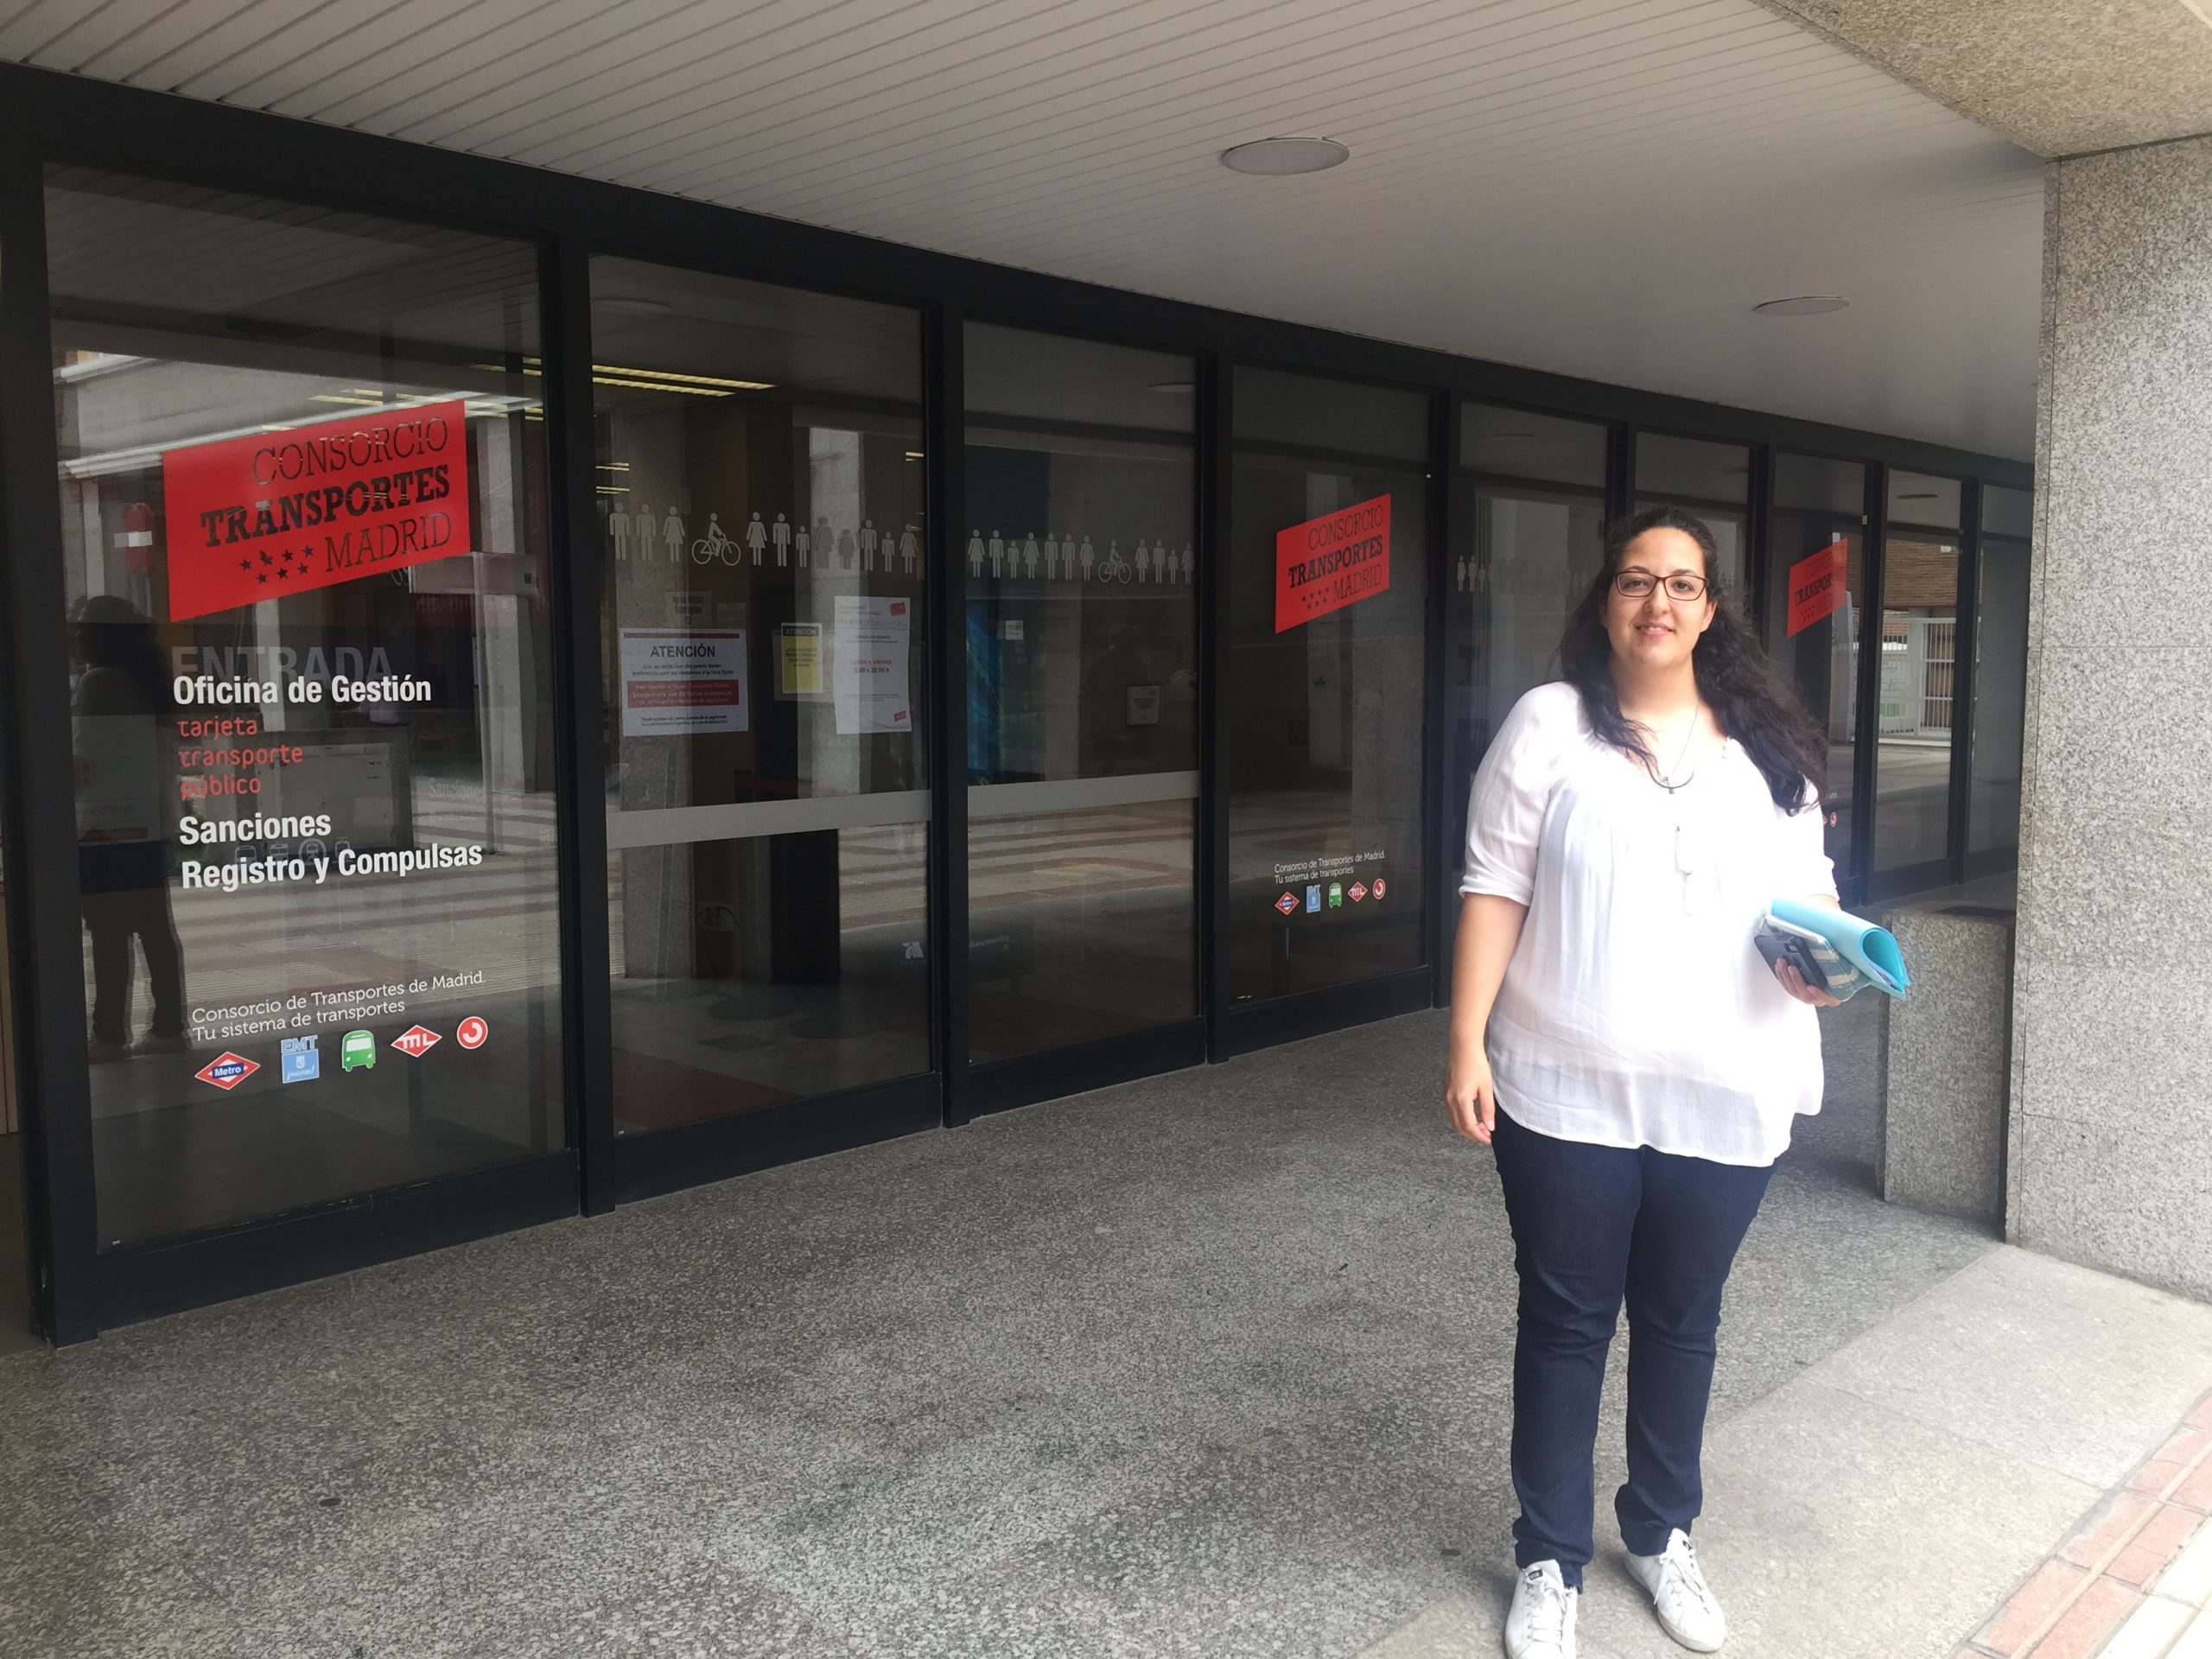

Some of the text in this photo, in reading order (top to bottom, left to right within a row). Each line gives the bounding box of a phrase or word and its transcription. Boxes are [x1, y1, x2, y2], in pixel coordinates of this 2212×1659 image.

[252, 417, 448, 485] CONSORCIO
[200, 464, 451, 548] TRANSPORTES
[324, 511, 452, 572] MADRID
[1308, 505, 1383, 550] CONSORCIO
[1288, 535, 1383, 589] TRANSPORTES
[1332, 563, 1383, 603] MADRID
[173, 645, 393, 689] ENTRADA
[650, 643, 716, 658] ATENCIÓN
[174, 674, 432, 706] Oficina de Gestión
[178, 716, 258, 741] tarjeta
[178, 744, 304, 769] transporte
[180, 775, 262, 802] público
[179, 812, 332, 846] Sanciones
[181, 843, 484, 893] Registro y Compulsas
[1274, 861, 1308, 874] Consorcio
[1309, 860, 1318, 869] de
[1318, 855, 1354, 868] Transportes
[1355, 854, 1363, 862] de
[1274, 866, 1354, 884] Tu sistema de transportes
[192, 998, 282, 1024] Consorcio
[286, 993, 308, 1010] de
[311, 983, 405, 1006] Transportes
[409, 978, 428, 995] de
[192, 999, 406, 1042] Tu sistema de transportes
[280, 1034, 319, 1054] EMT
[213, 1064, 243, 1078] Metro
